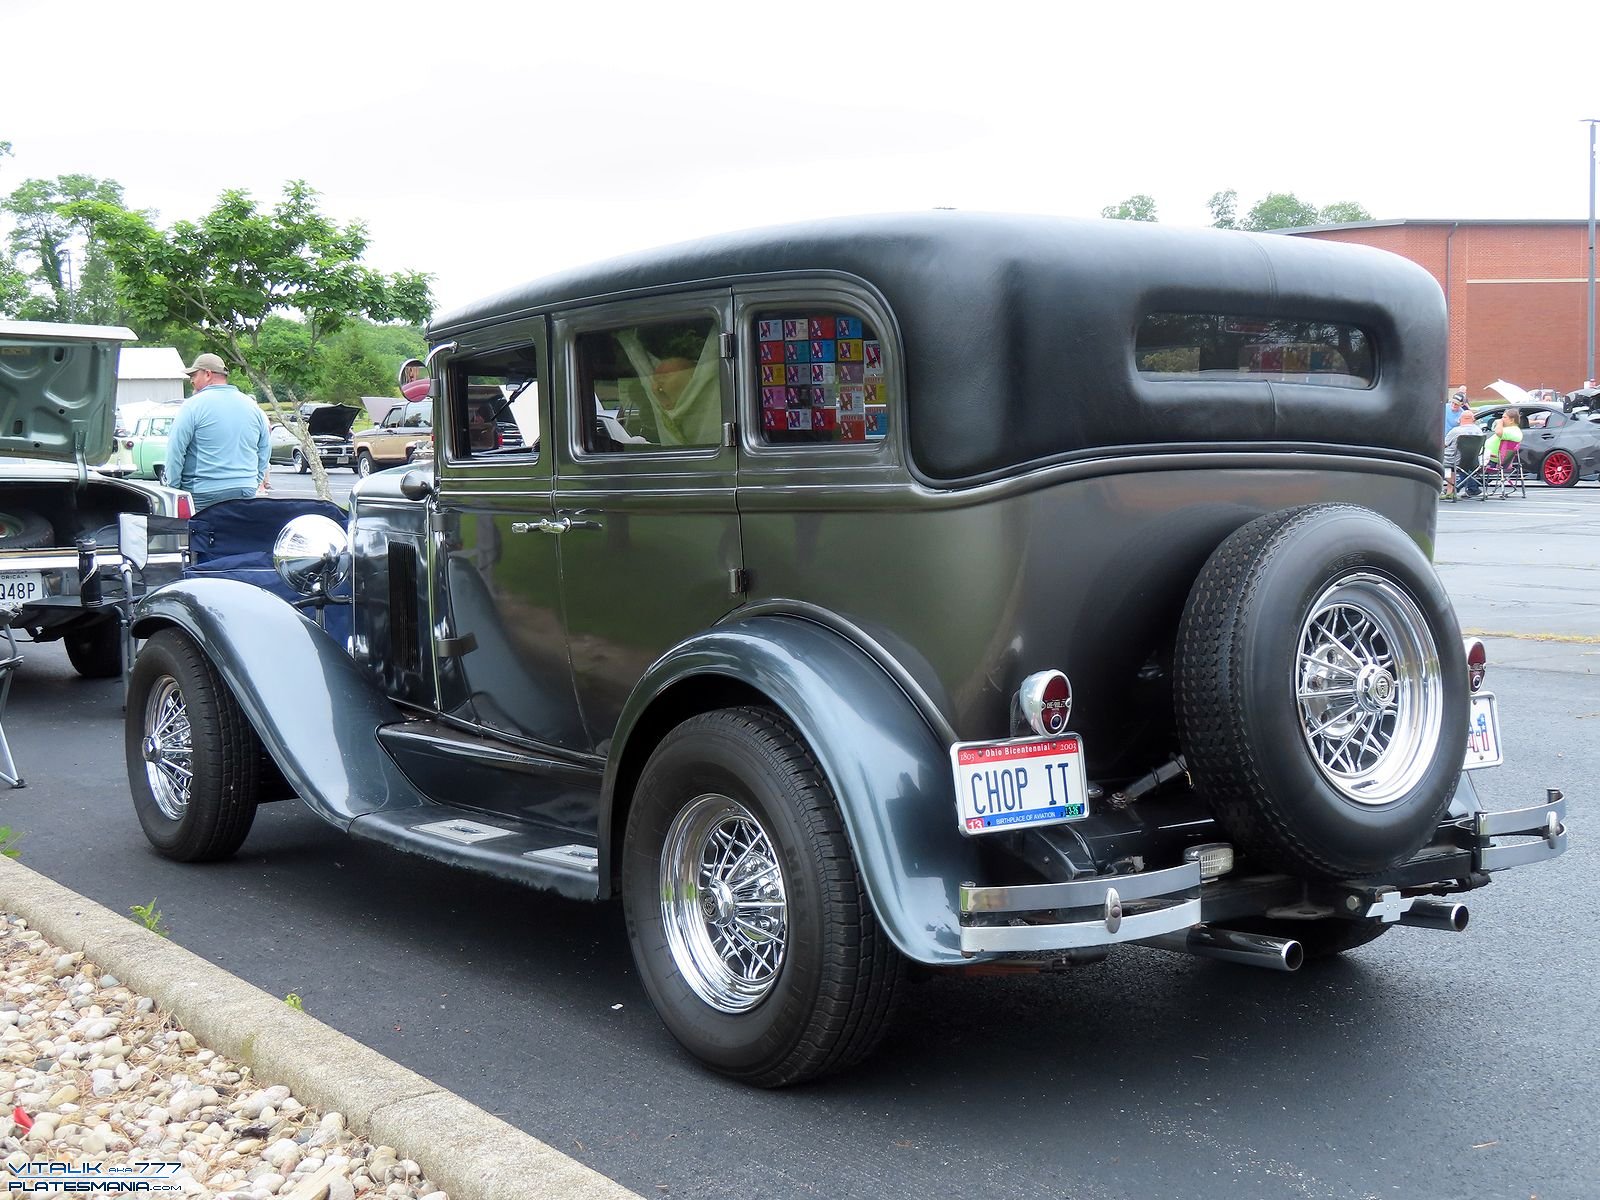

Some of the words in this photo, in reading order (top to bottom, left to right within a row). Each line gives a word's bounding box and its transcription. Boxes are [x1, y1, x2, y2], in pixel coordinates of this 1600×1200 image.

[985, 748, 1003, 757] Ohio
[1005, 743, 1051, 756] Bicentennial
[971, 767, 1029, 814] CHOP
[1045, 762, 1069, 806] IT
[996, 815, 1026, 825] BIRTHPLACE
[1026, 813, 1034, 821] OF
[1033, 811, 1056, 820] AVIATION
